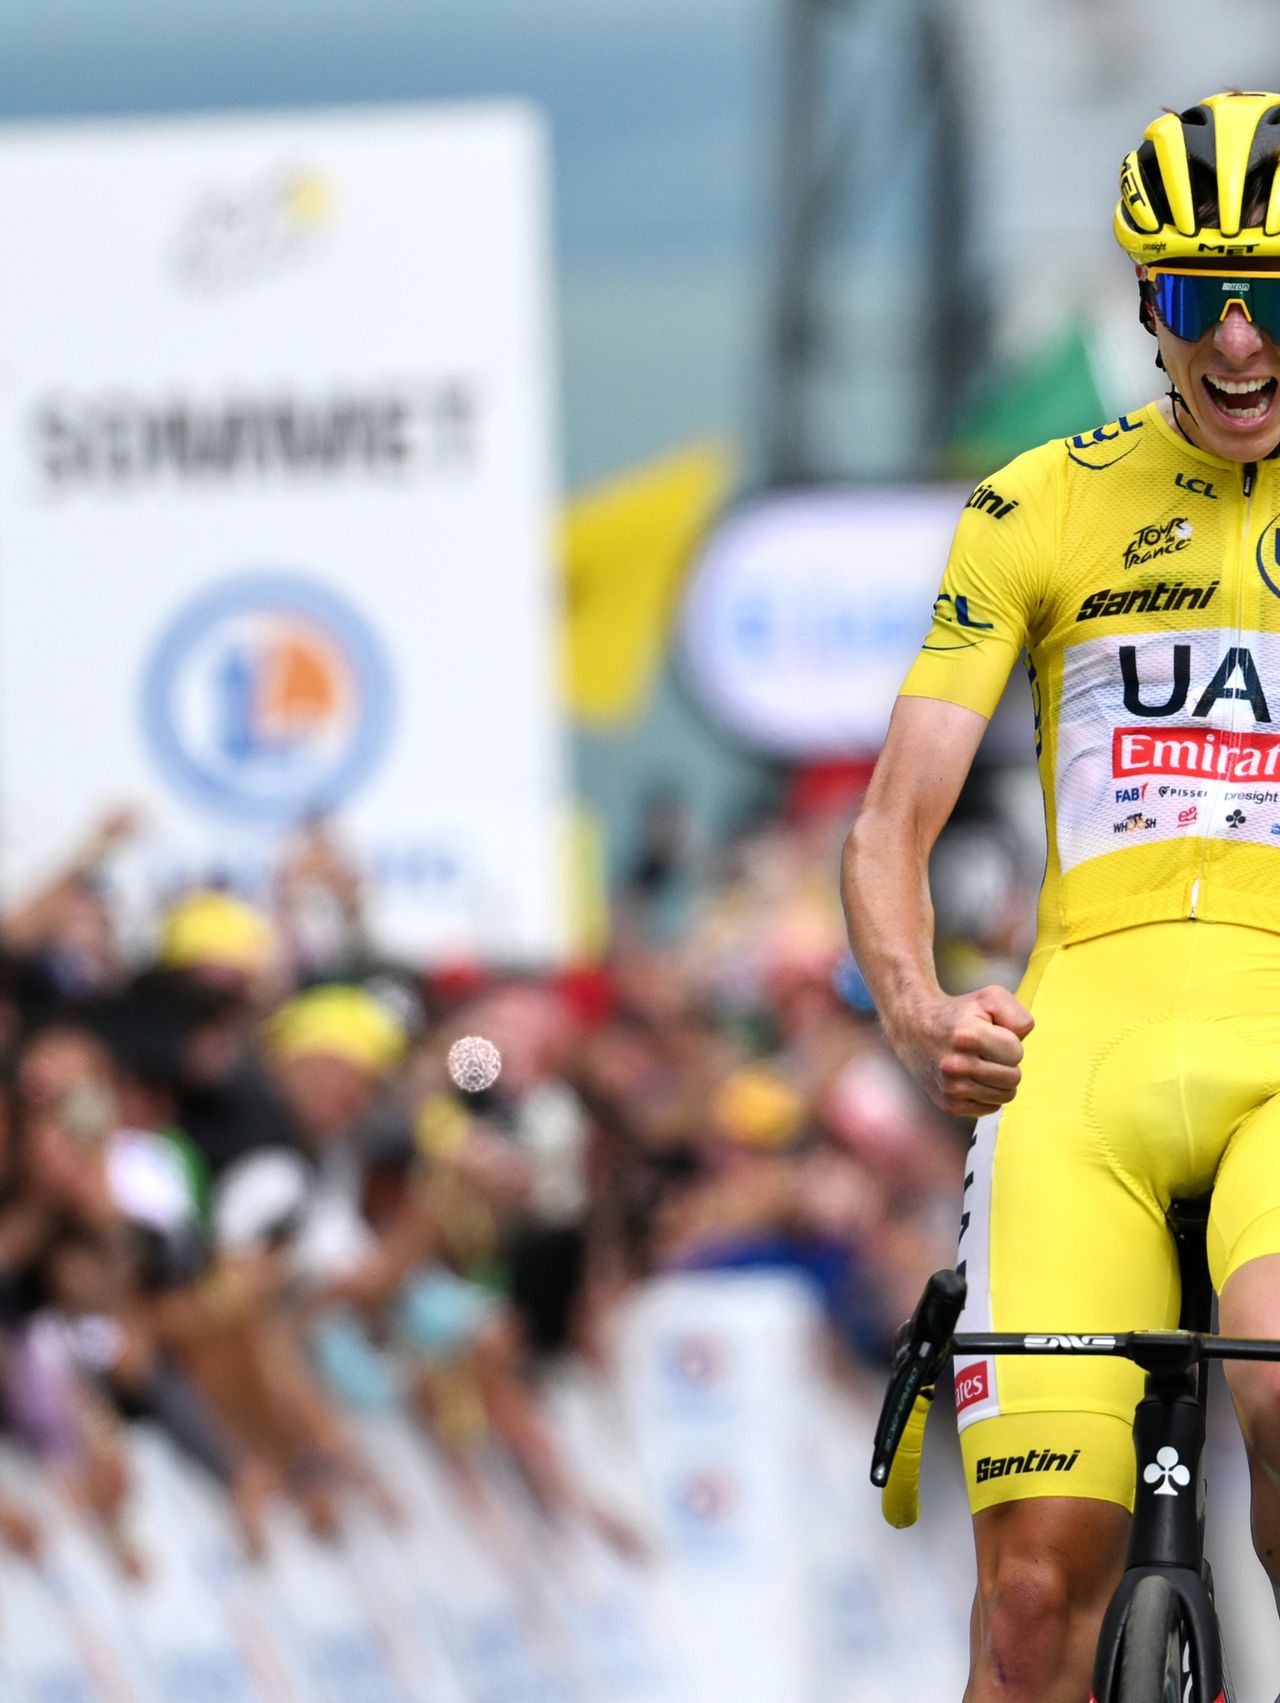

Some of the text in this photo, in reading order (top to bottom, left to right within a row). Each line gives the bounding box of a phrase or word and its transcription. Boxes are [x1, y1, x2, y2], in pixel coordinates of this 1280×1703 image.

[1198, 243, 1260, 257] MET
[1072, 416, 1143, 449] LCL
[1174, 473, 1218, 499] LCL
[1076, 580, 1220, 622] Santini
[1170, 788, 1208, 798] PISSEI
[1225, 790, 1278, 805] presight
[976, 1448, 1081, 1484] Santini
